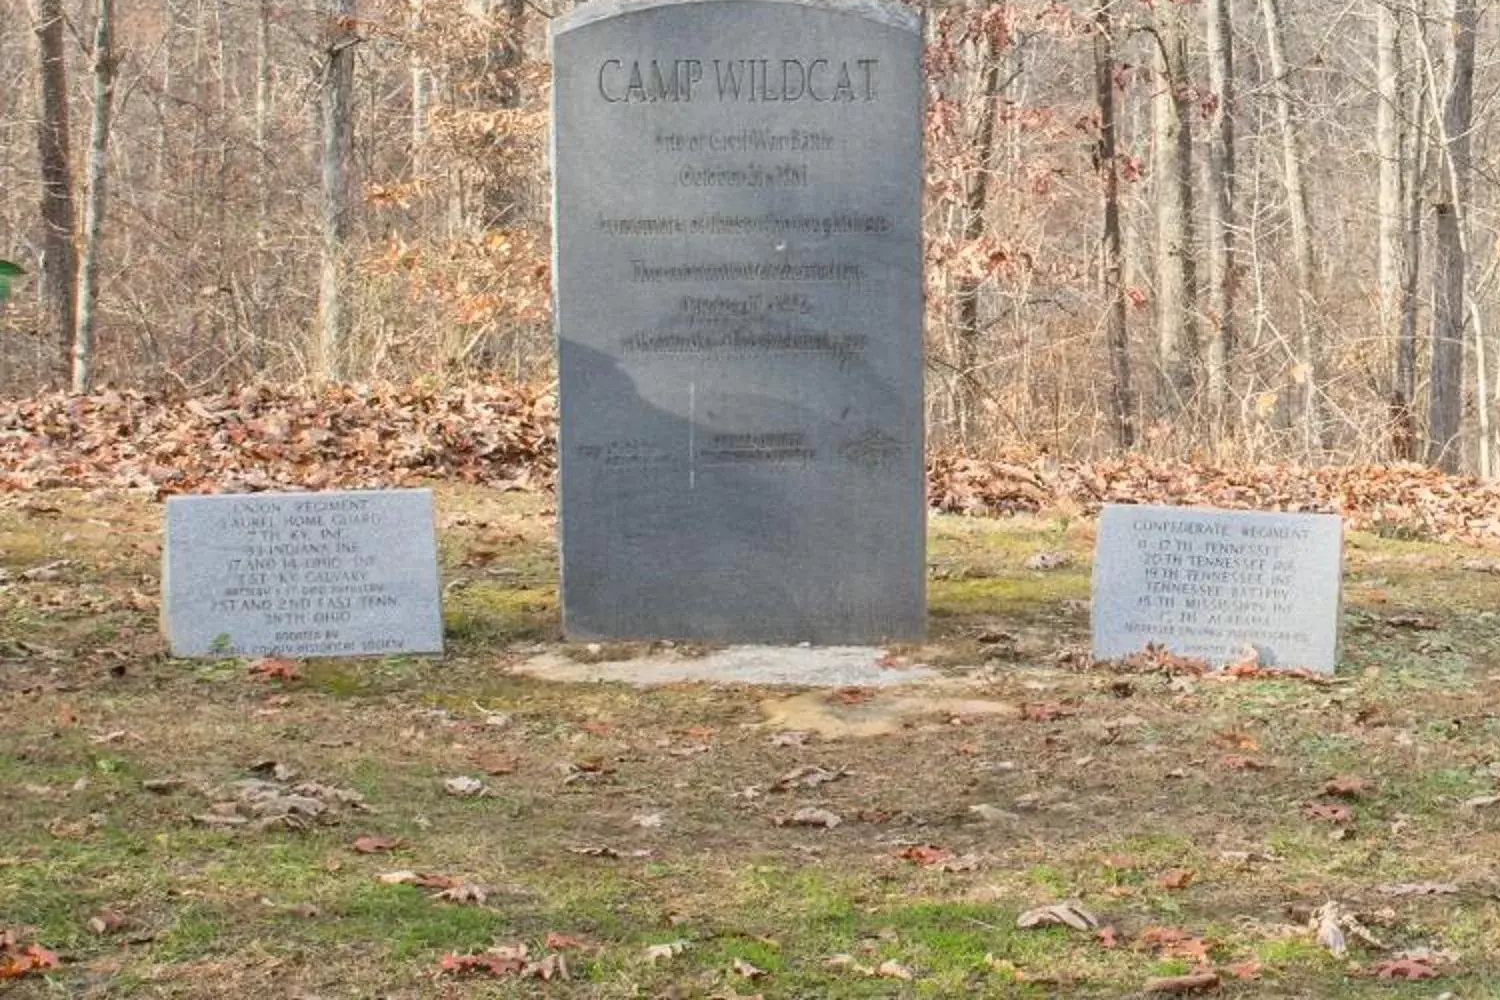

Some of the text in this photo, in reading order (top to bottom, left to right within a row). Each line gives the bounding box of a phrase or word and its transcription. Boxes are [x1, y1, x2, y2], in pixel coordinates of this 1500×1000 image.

[598, 59, 881, 102] CAMP WILDCAT
[286, 515, 324, 527] HOME
[1133, 520, 1230, 537] CONFEDERATE
[1188, 555, 1266, 571] TENNESSEE
[304, 570, 368, 583] CALVARY
[1187, 569, 1264, 585] TENNESSEE
[1147, 581, 1223, 597] TENNESSEE
[317, 597, 352, 610] EAST
[312, 610, 352, 624] OHIO
